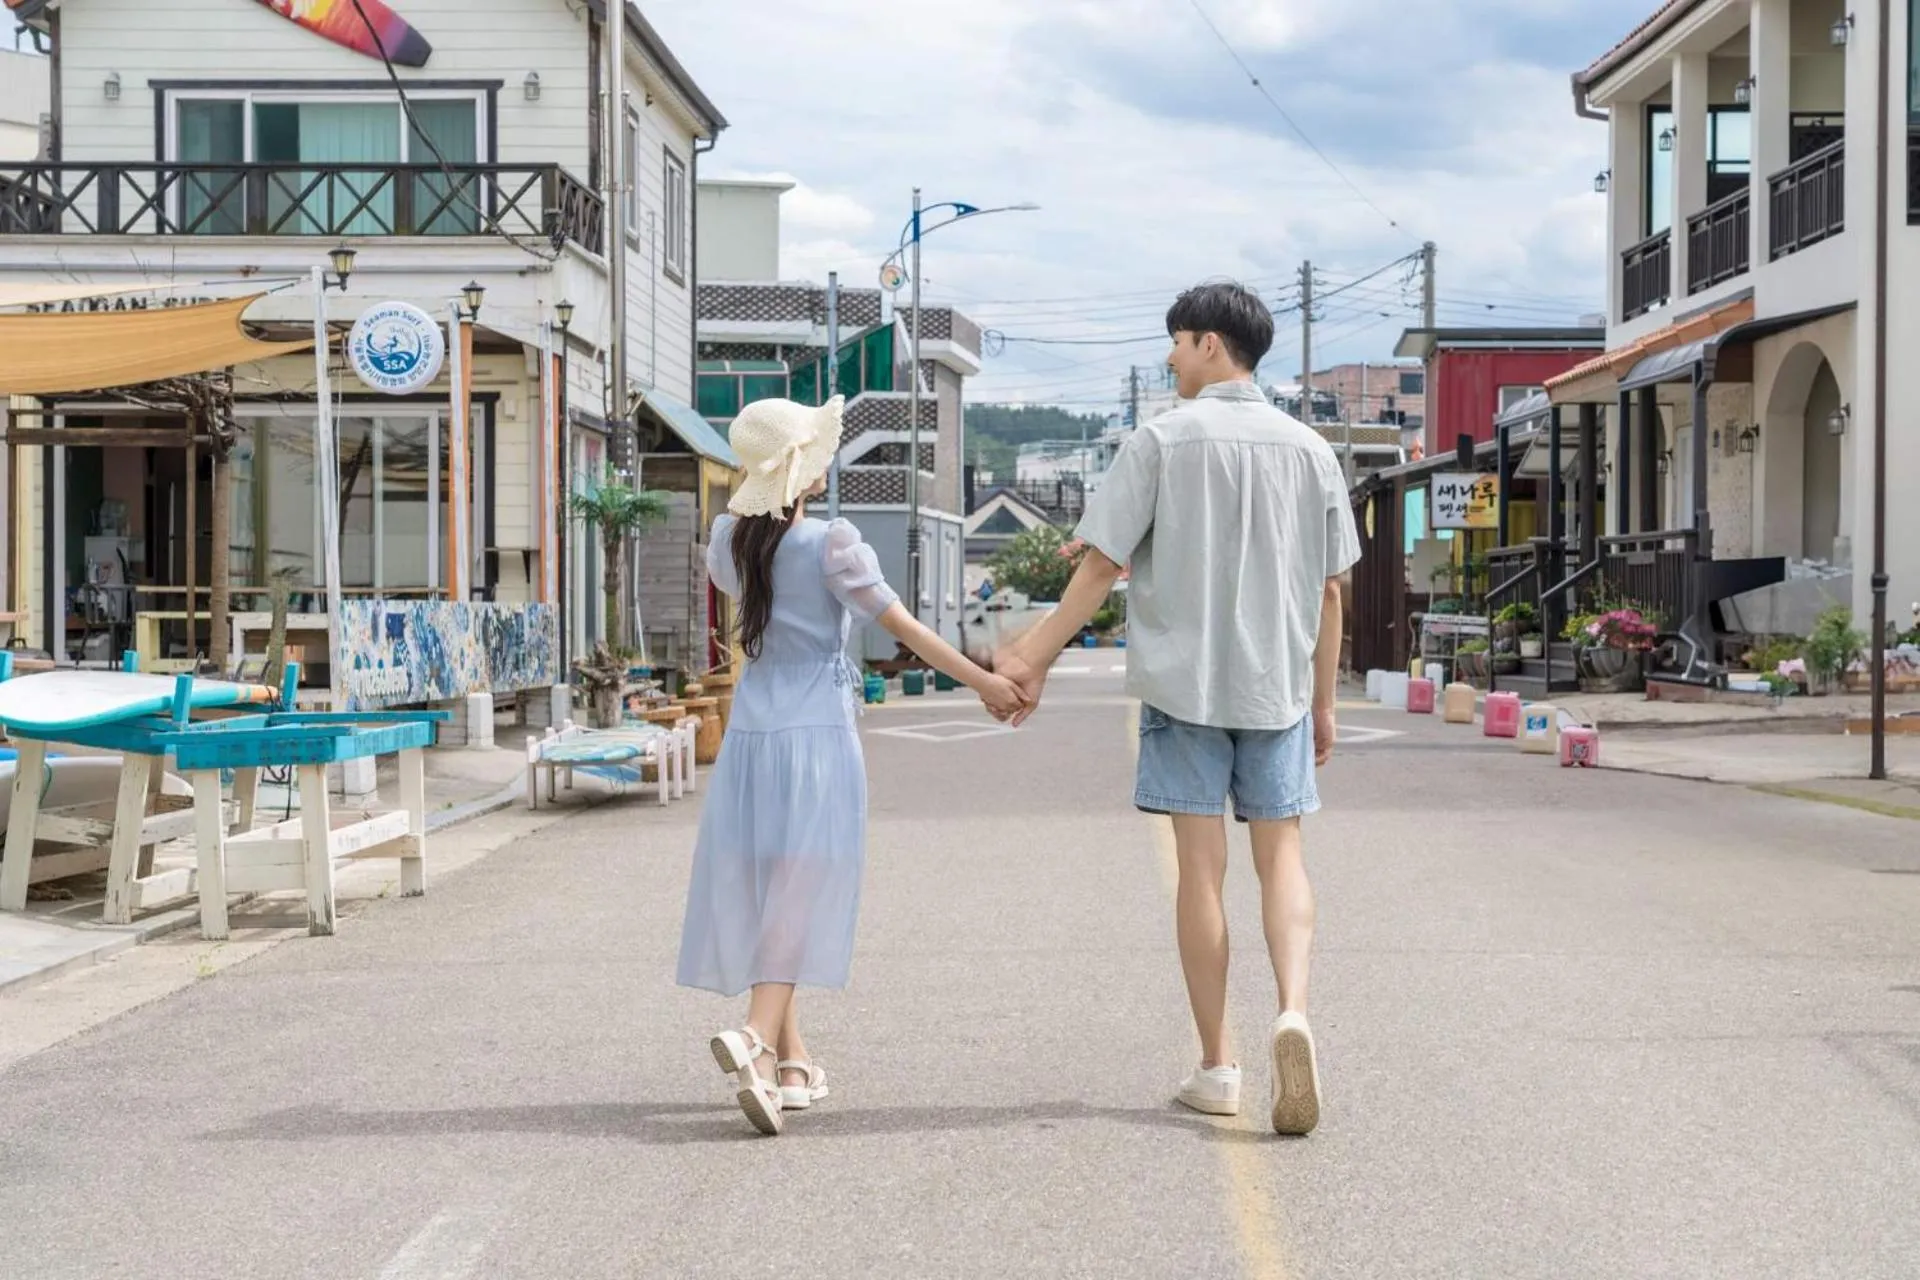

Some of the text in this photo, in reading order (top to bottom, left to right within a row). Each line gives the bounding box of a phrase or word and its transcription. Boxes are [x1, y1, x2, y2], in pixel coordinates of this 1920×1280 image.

[363, 310, 423, 327] Seaman Surf
[383, 359, 407, 370] SSA
[1438, 482, 1496, 508] 새나루
